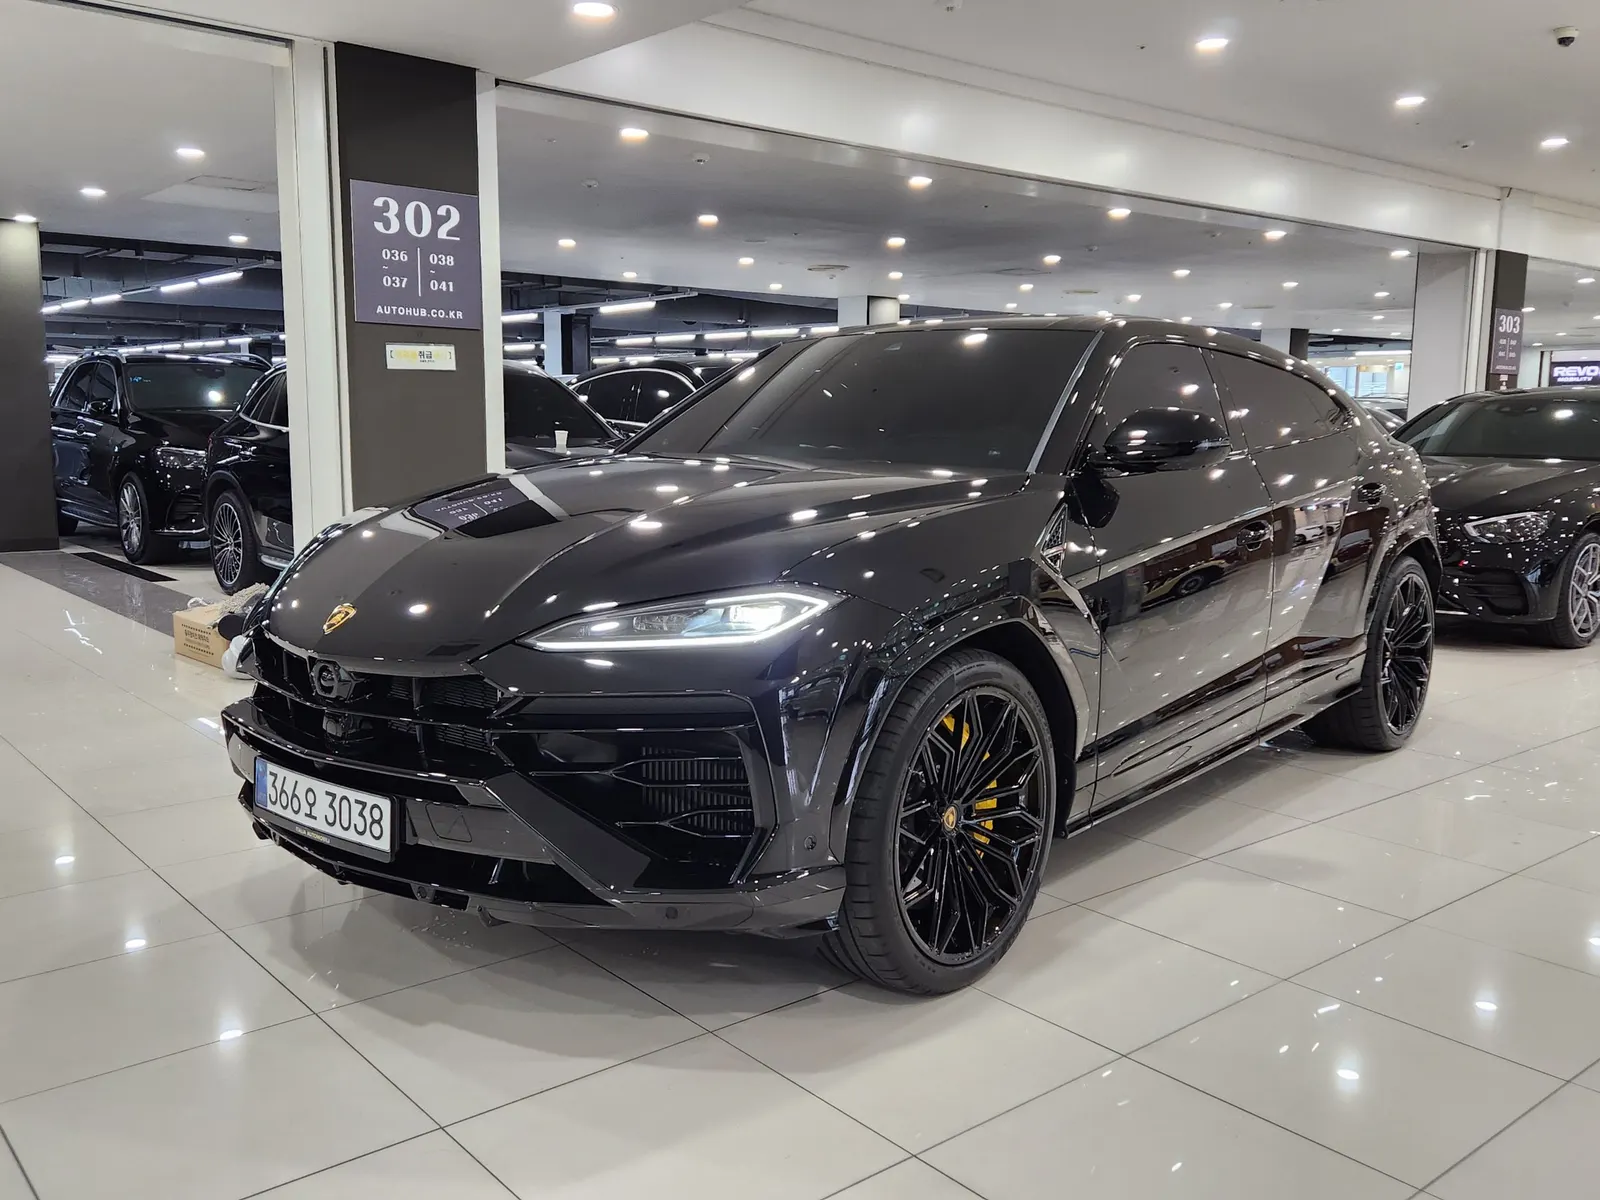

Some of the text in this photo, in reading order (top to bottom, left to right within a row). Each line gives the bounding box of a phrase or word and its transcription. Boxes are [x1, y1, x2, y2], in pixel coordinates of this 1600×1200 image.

[373, 196, 460, 241] 302
[381, 248, 408, 262] 036
[429, 253, 455, 266] 038
[382, 275, 408, 288] 037
[429, 280, 454, 292] 041
[376, 305, 463, 320] AUTOHUB.CO.KR
[1499, 314, 1520, 333] 303
[1553, 366, 1600, 377] REVO
[268, 770, 384, 841] 366오 3038
